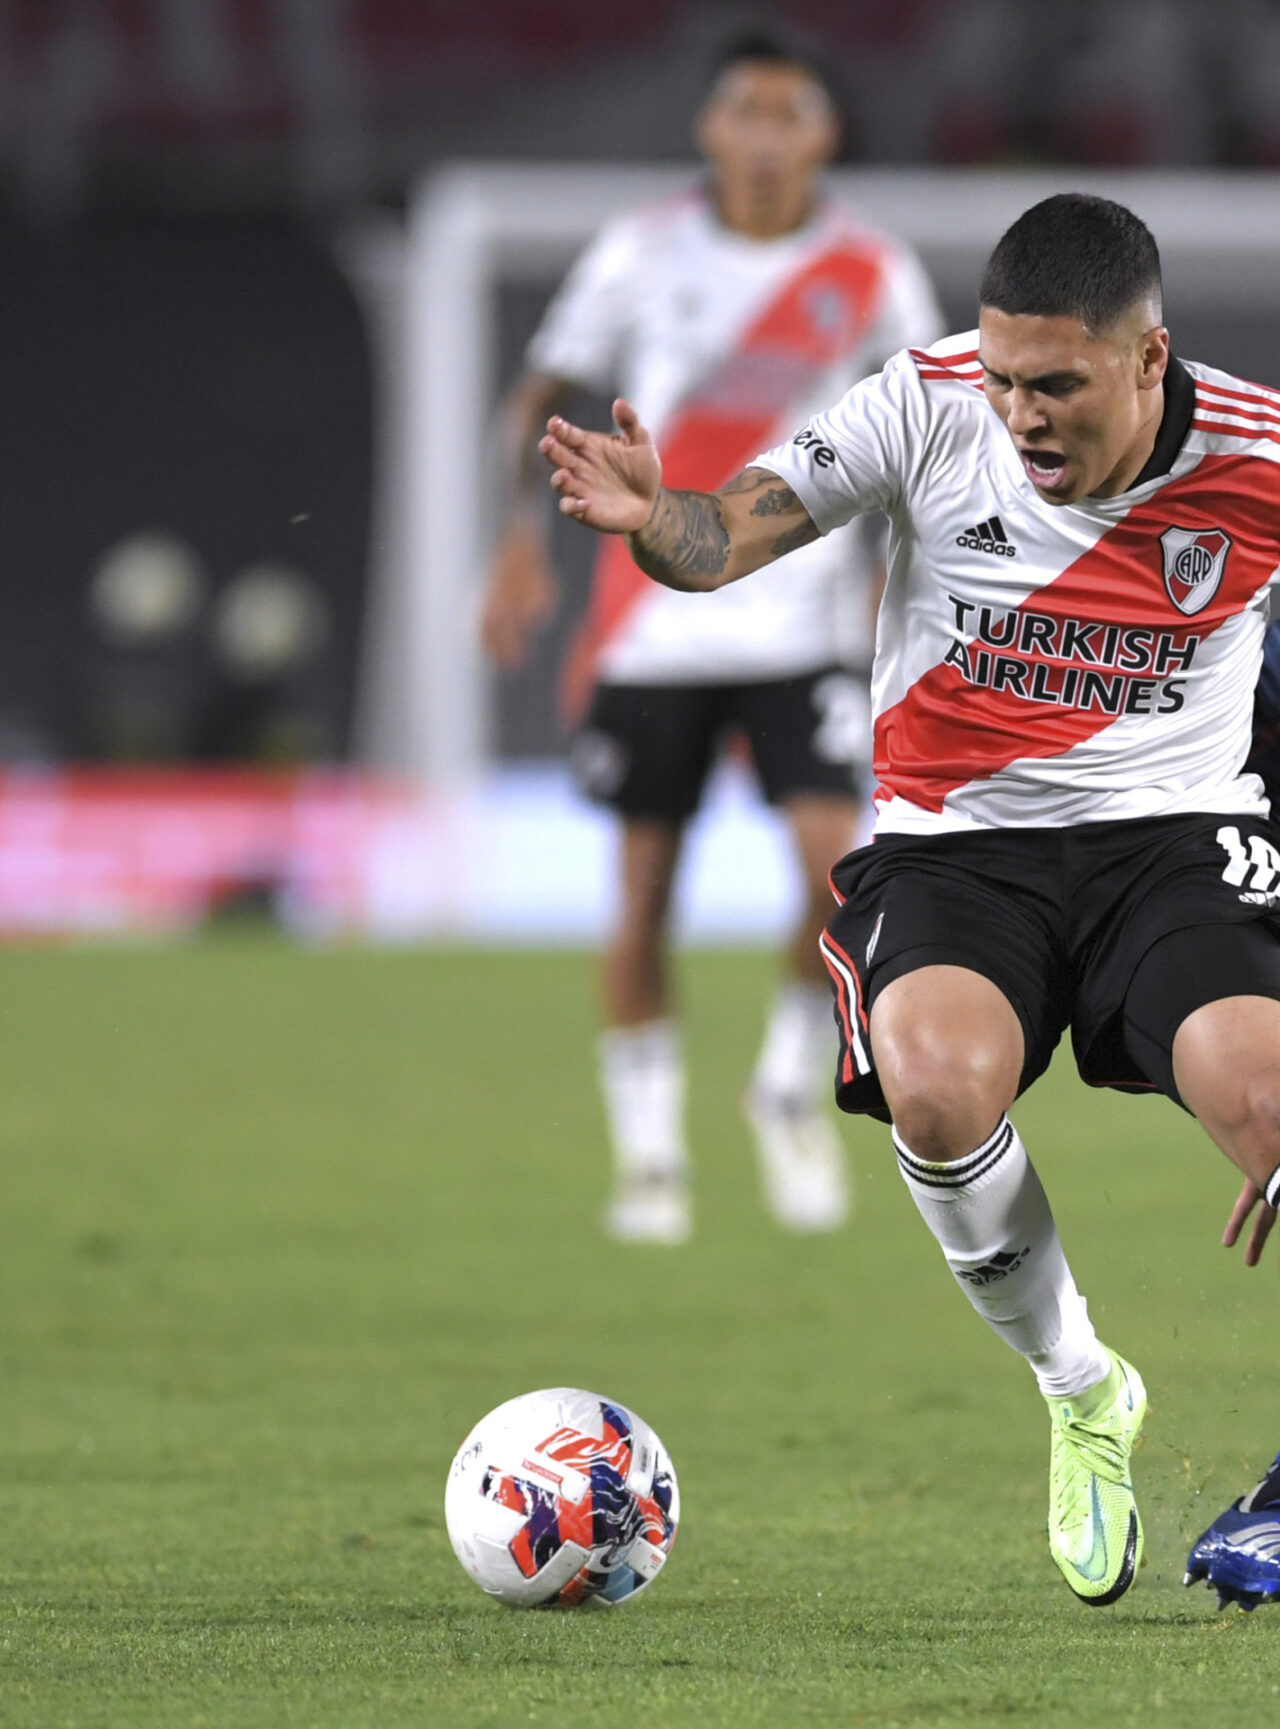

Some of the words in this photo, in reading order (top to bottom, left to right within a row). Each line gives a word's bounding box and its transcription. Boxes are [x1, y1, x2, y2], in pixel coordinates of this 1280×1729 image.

[955, 535, 1017, 558] adidas
[948, 594, 1200, 674] TURKISH
[943, 638, 1187, 716] AIRLINES
